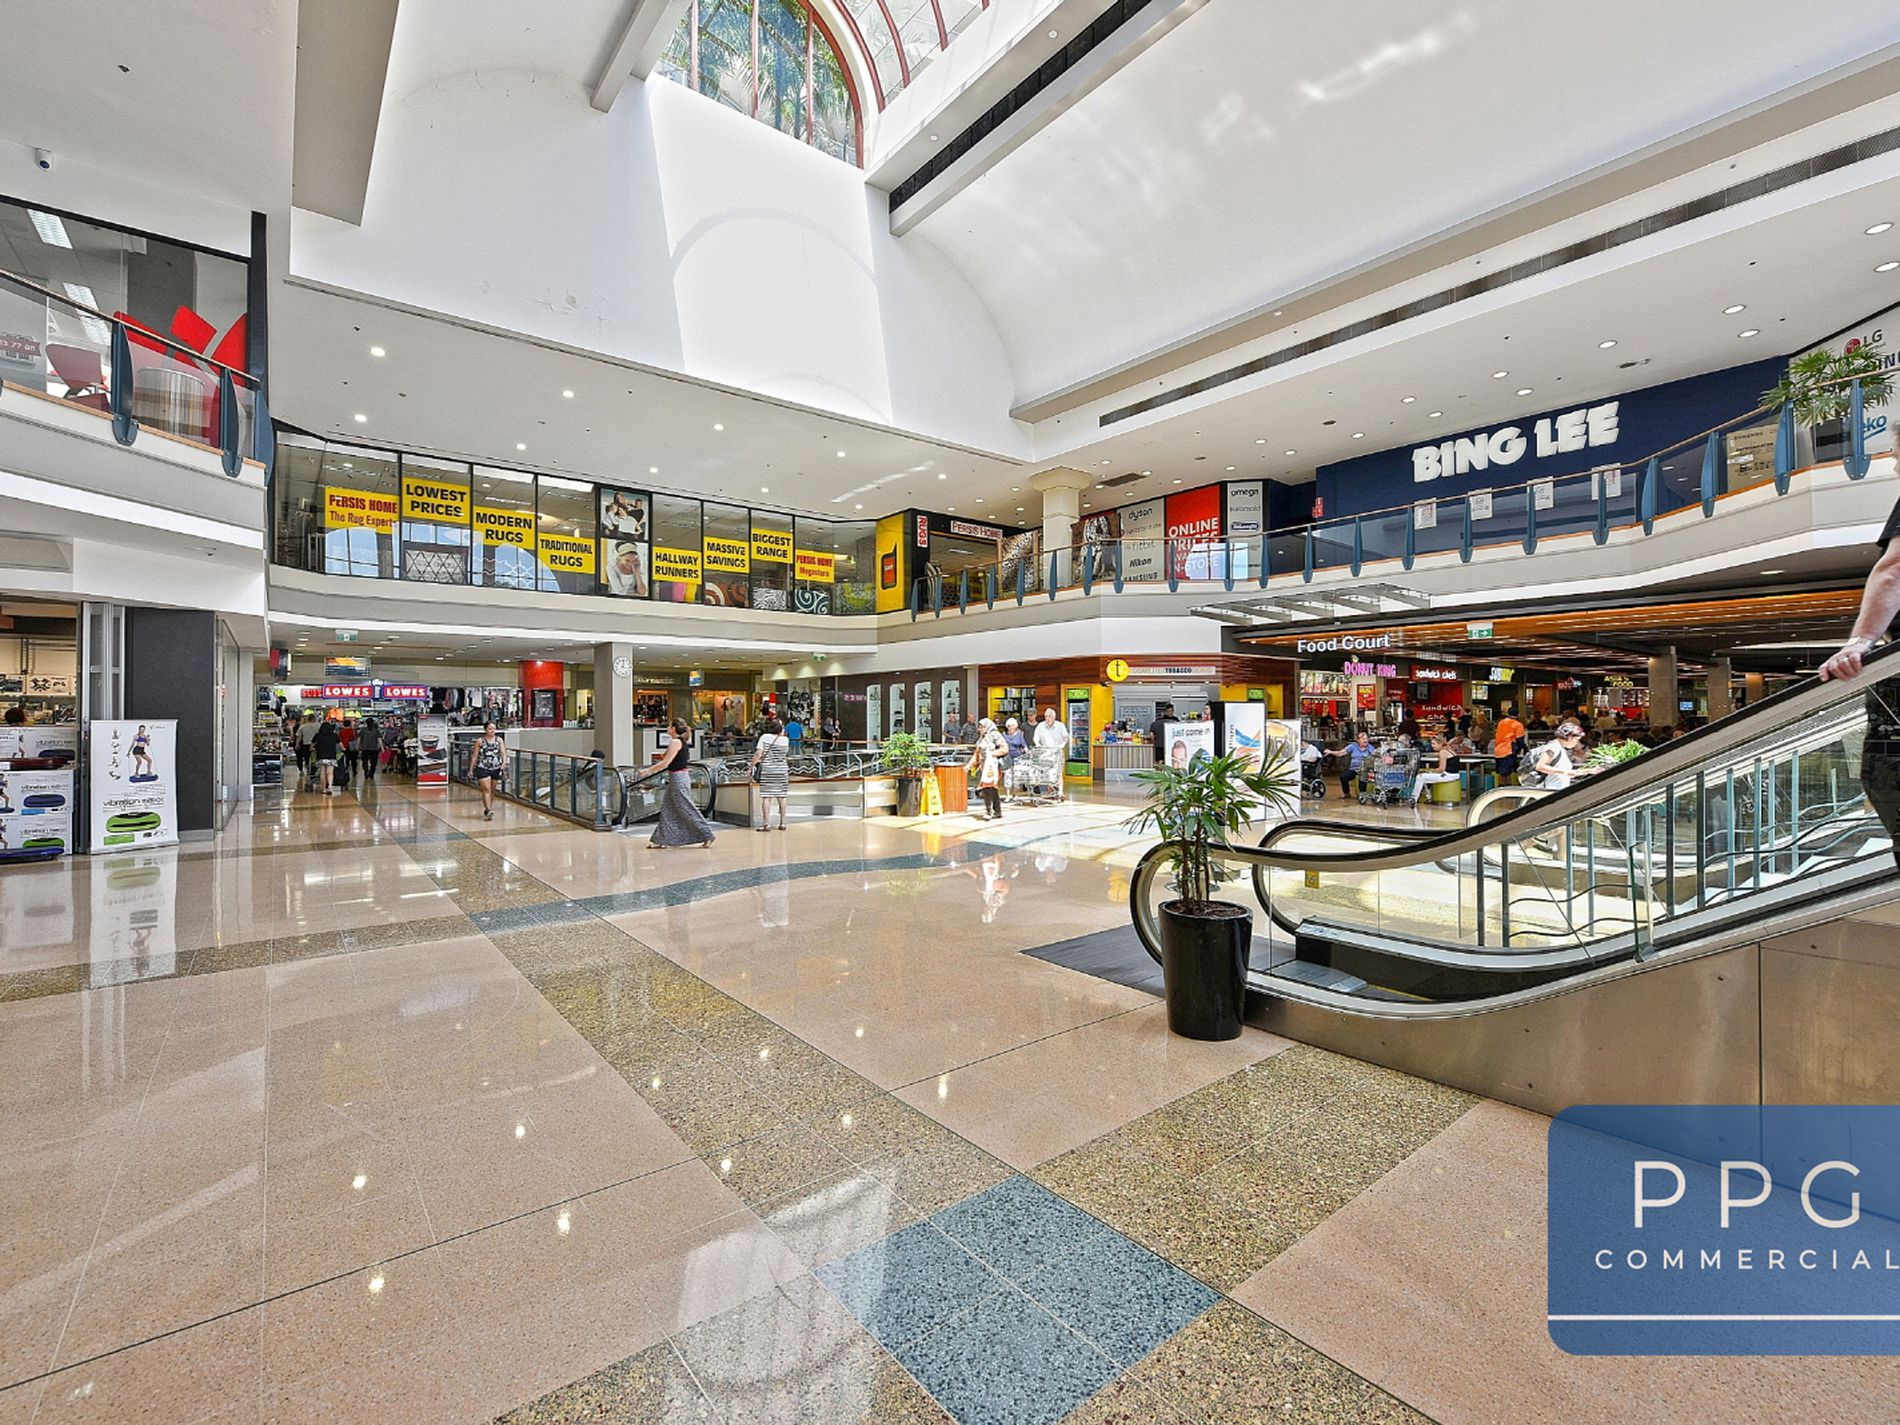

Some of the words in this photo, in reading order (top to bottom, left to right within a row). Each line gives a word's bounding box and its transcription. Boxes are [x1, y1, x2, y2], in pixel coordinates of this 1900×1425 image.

[1864, 329, 1882, 346] LG
[1412, 426, 1527, 483] BING
[1533, 401, 1619, 458] LEE
[406, 484, 467, 502] LOWEST
[1231, 489, 1258, 497] omega
[329, 495, 366, 510] PERSIS
[369, 500, 397, 513] HOME
[411, 500, 464, 517] PRICES
[330, 511, 345, 522] The
[348, 513, 364, 526] Rug
[476, 512, 532, 529] MODERN
[1129, 508, 1152, 521] dyson
[918, 517, 927, 546] RUGS
[953, 522, 979, 534] PERSIS
[980, 527, 1001, 539] HOME
[1169, 517, 1218, 537] ONLINE
[485, 529, 523, 543] RUGS
[753, 533, 791, 546] BIGGEST
[540, 539, 593, 554] TRADITIONAL
[707, 542, 745, 556] MASSIVE
[756, 546, 788, 558] RANGE
[550, 555, 583, 567] RUGS
[655, 552, 699, 566] HALLWAY
[706, 555, 746, 568] SAVINGS
[797, 554, 815, 565] PERSIS
[1129, 558, 1152, 567] Nikon
[655, 567, 699, 579] RUNNERS
[1297, 638, 1337, 653] Food
[1342, 634, 1390, 650] Court
[1344, 662, 1374, 676] DONUT
[1377, 664, 1396, 678] KING
[326, 687, 369, 696] LOWES
[386, 687, 425, 696] LOWES
[1172, 728, 1184, 738] just
[1186, 728, 1203, 736] come
